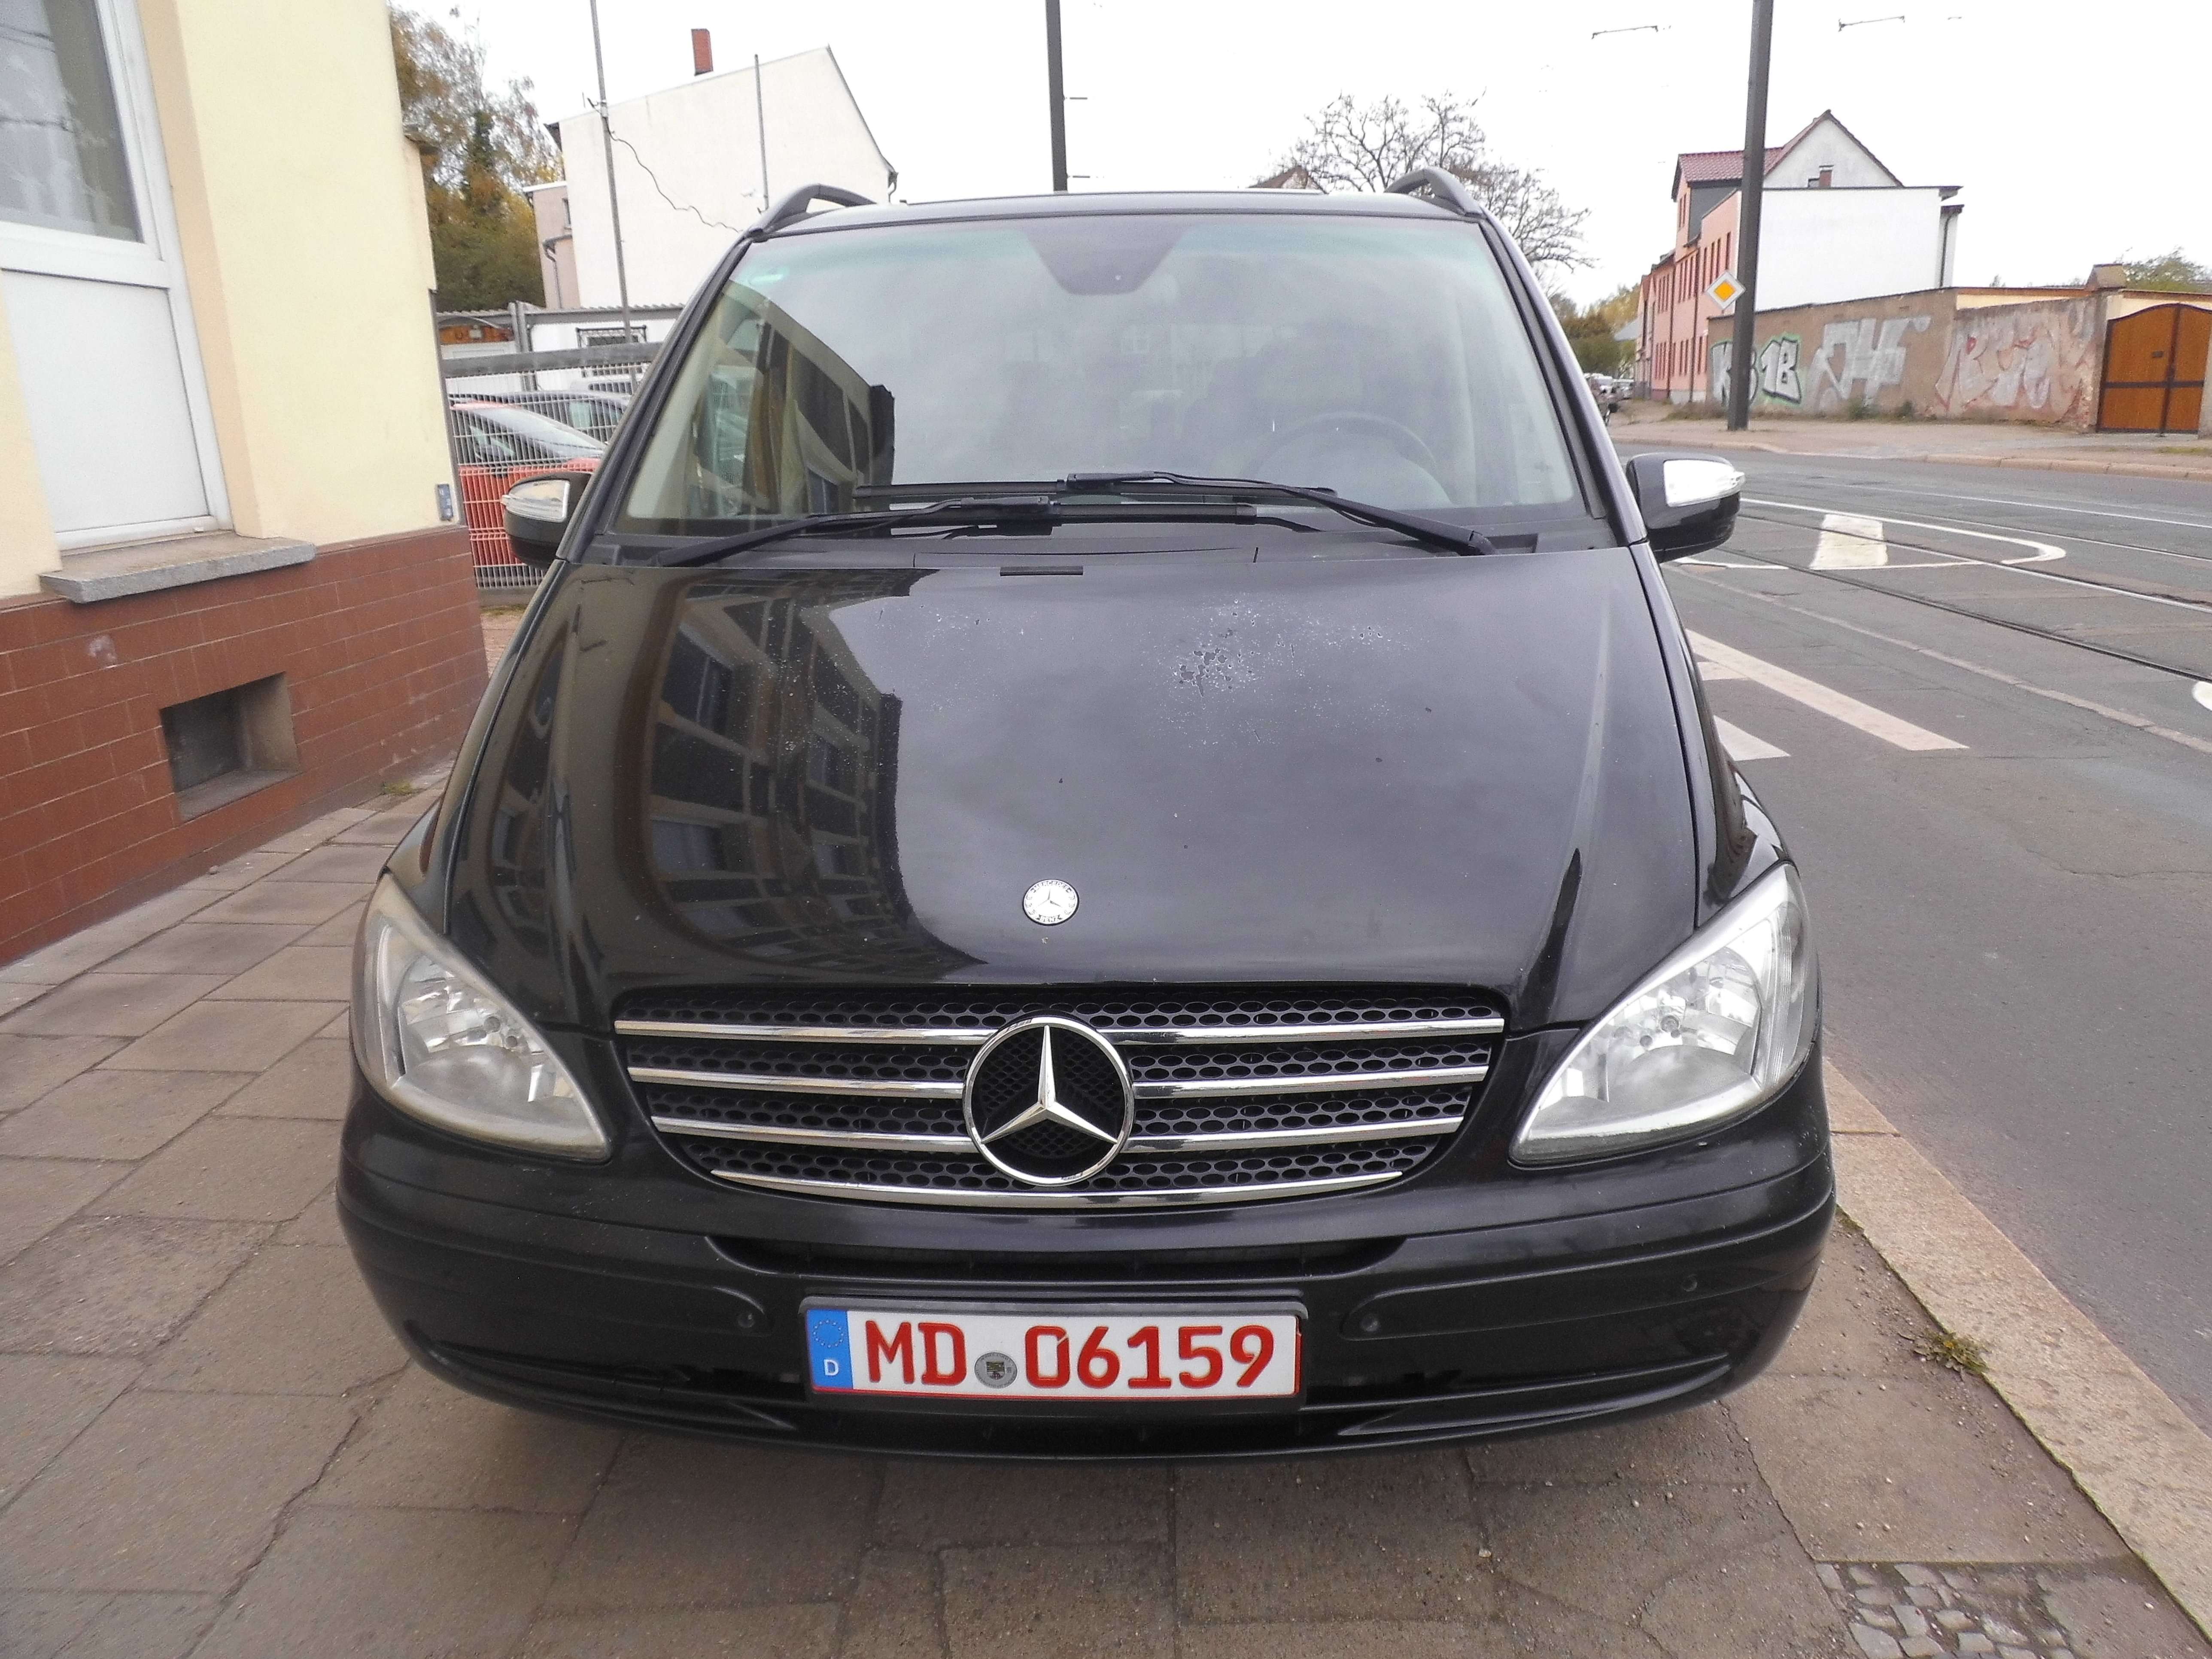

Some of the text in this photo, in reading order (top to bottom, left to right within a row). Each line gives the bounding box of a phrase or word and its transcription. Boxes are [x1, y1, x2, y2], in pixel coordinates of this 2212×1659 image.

[823, 1359, 839, 1376] D
[865, 1320, 1275, 1389] MD 06159
